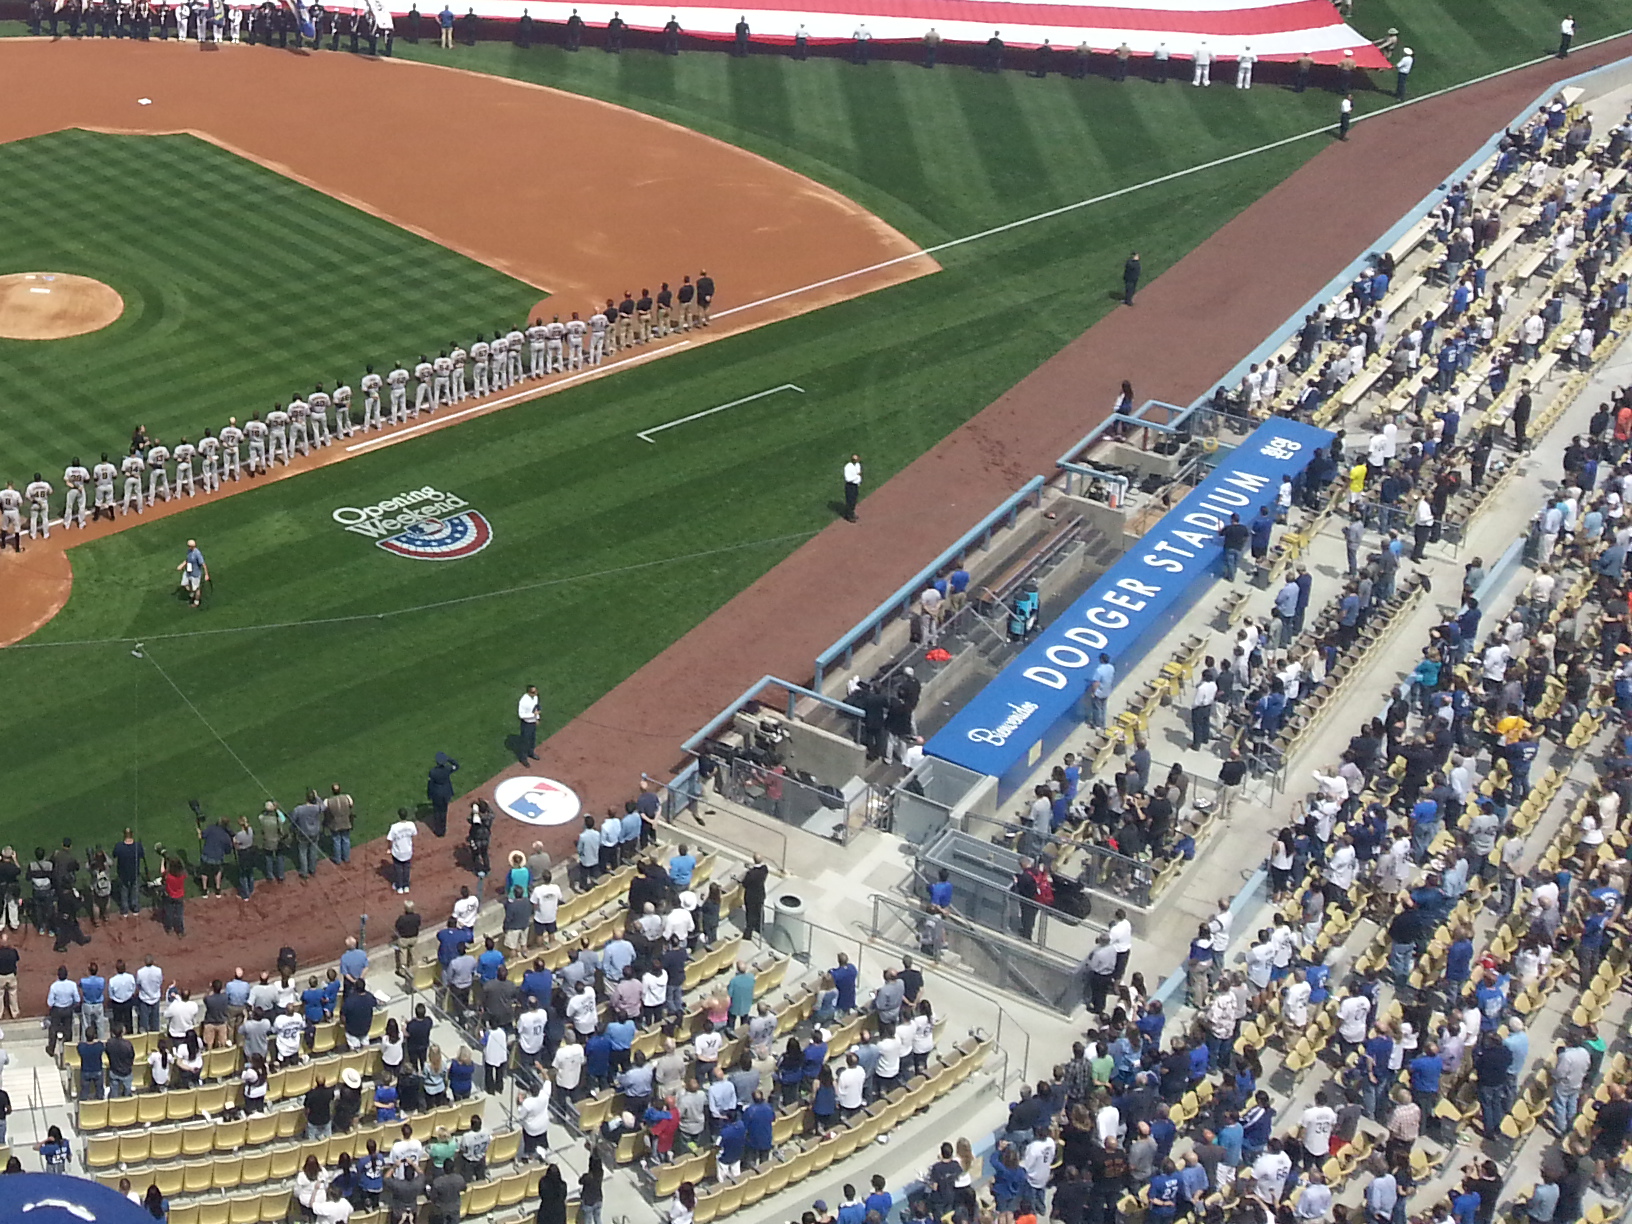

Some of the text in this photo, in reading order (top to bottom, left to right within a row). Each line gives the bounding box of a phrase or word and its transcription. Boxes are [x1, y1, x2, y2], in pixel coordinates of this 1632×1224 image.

[333, 486, 445, 524] Opening
[345, 492, 469, 538] Weekend
[1023, 578, 1162, 690] DODGER
[1143, 470, 1270, 573] STADIUM
